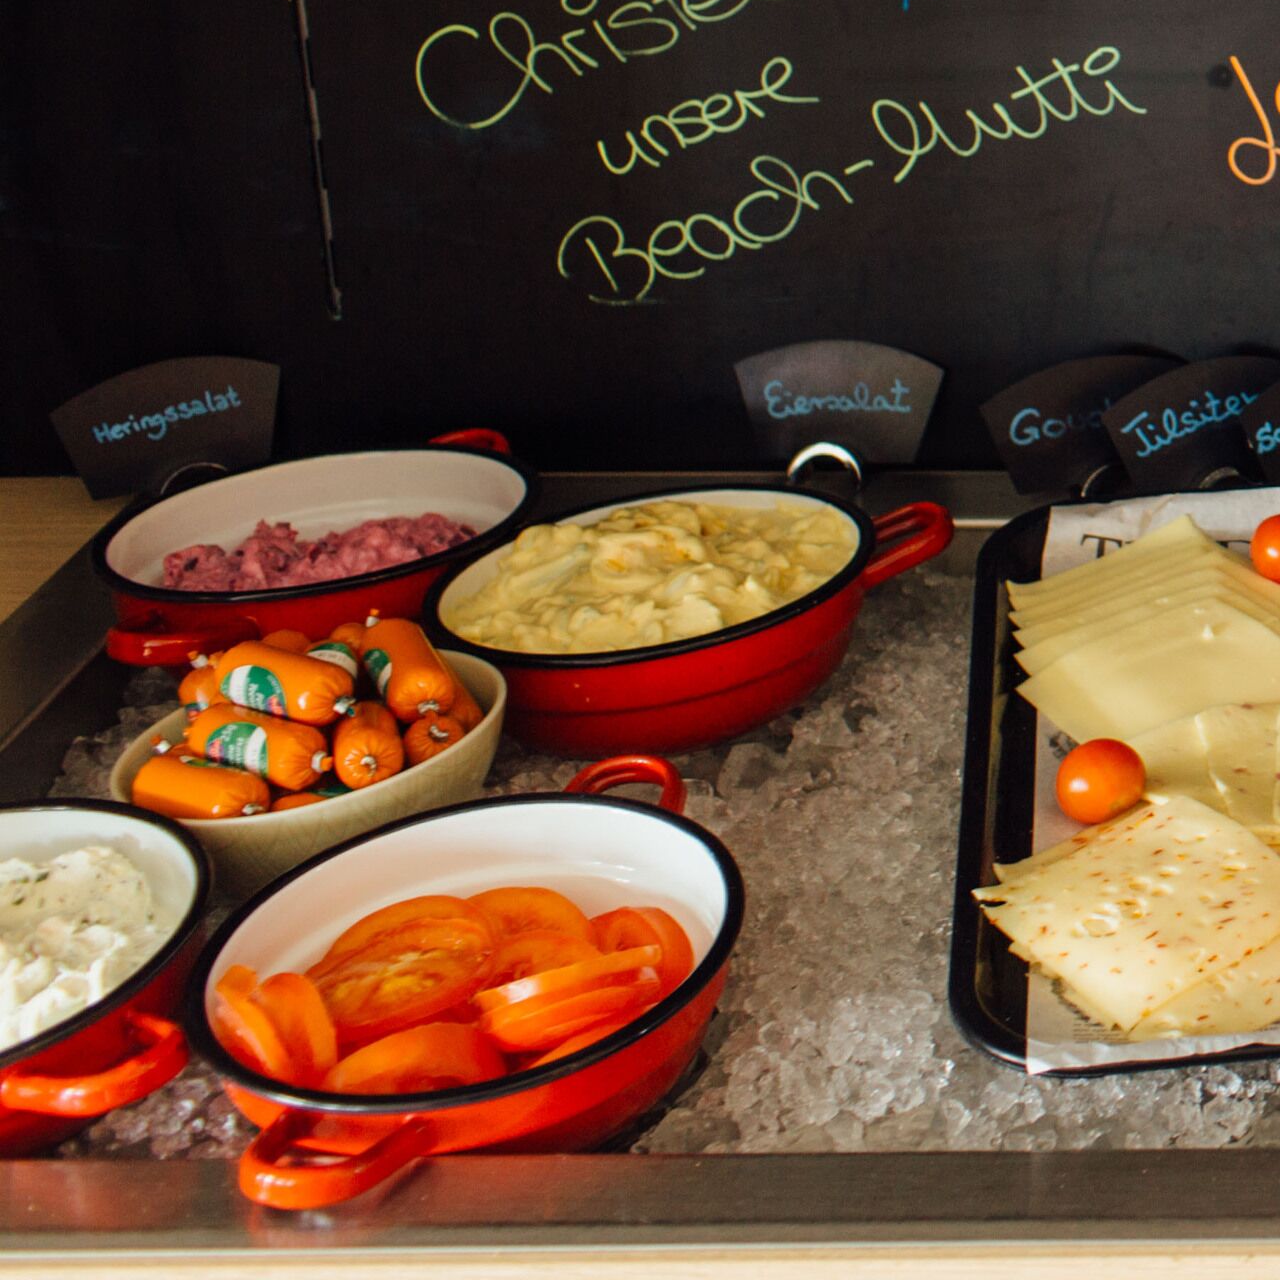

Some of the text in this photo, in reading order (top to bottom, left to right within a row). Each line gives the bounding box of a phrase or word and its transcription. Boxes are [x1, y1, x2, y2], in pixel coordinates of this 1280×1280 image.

[598, 57, 819, 175] unsere
[556, 46, 1147, 307] Beach-Mutti
[92, 385, 242, 444] Heringssalat
[763, 377, 912, 419] Eiersalat
